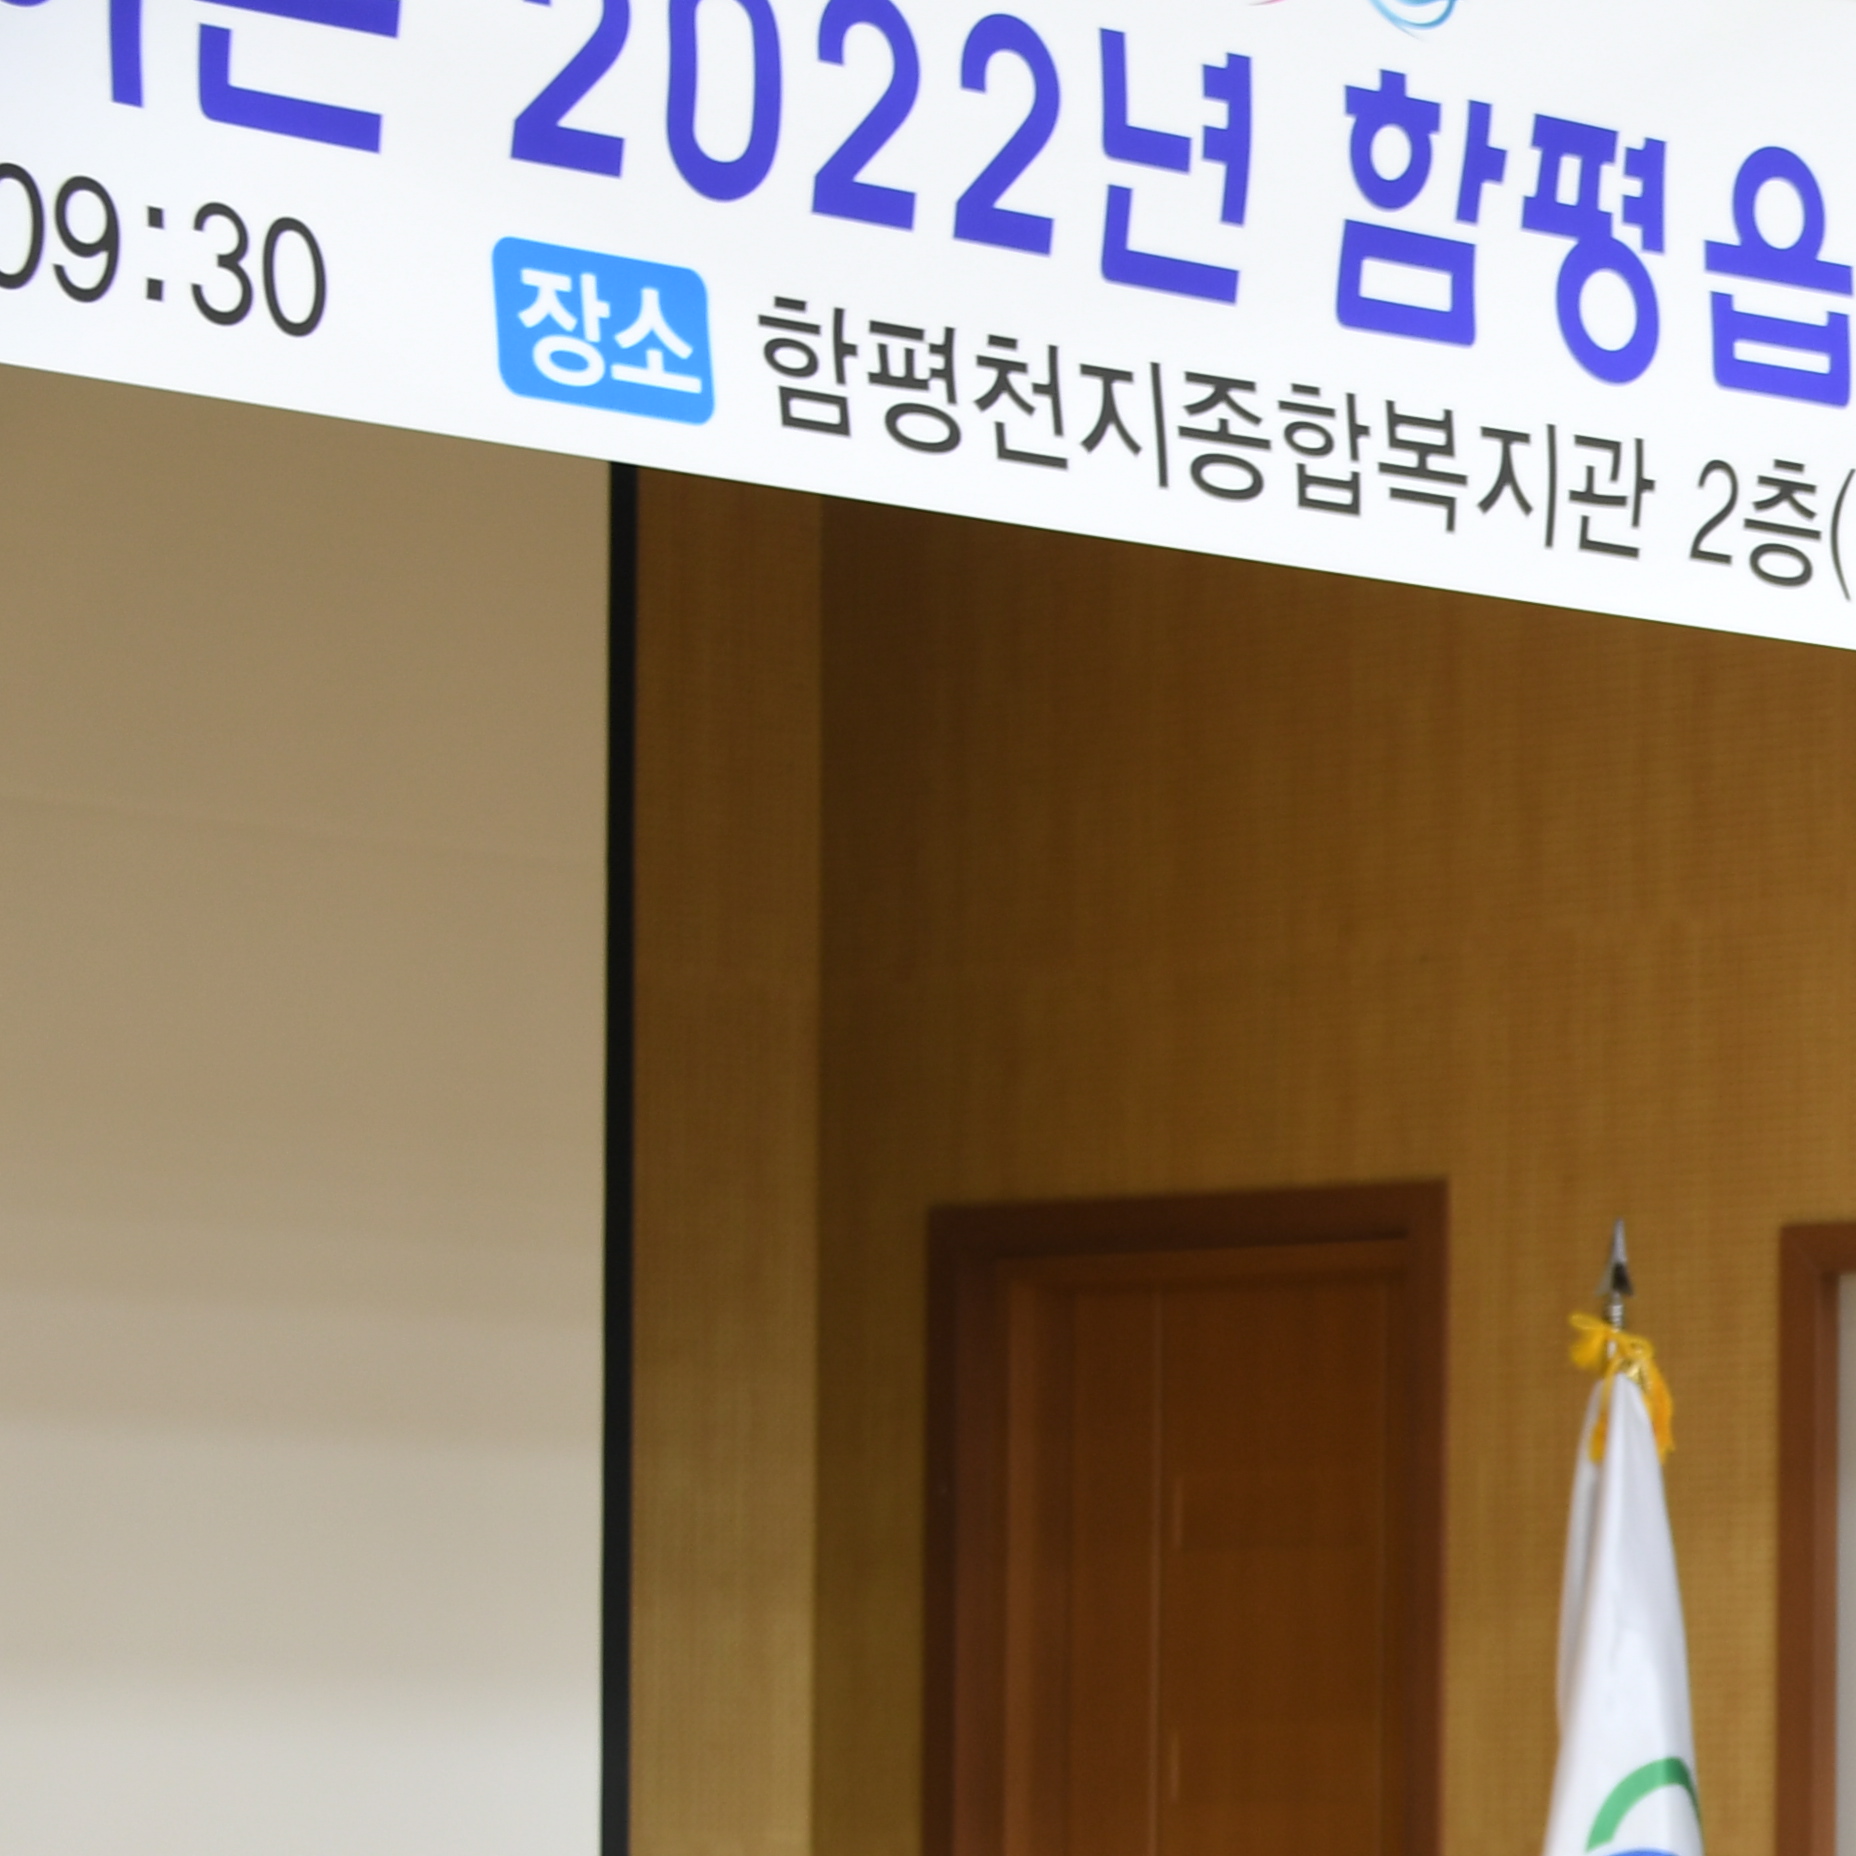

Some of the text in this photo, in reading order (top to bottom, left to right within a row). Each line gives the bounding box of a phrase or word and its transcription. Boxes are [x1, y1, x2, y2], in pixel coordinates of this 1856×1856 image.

[0, 162, 327, 338] 09:30
[513, 0, 1251, 303] 2022년
[519, 268, 703, 393] 장소
[757, 296, 1655, 560] 함평천지종합복지관
